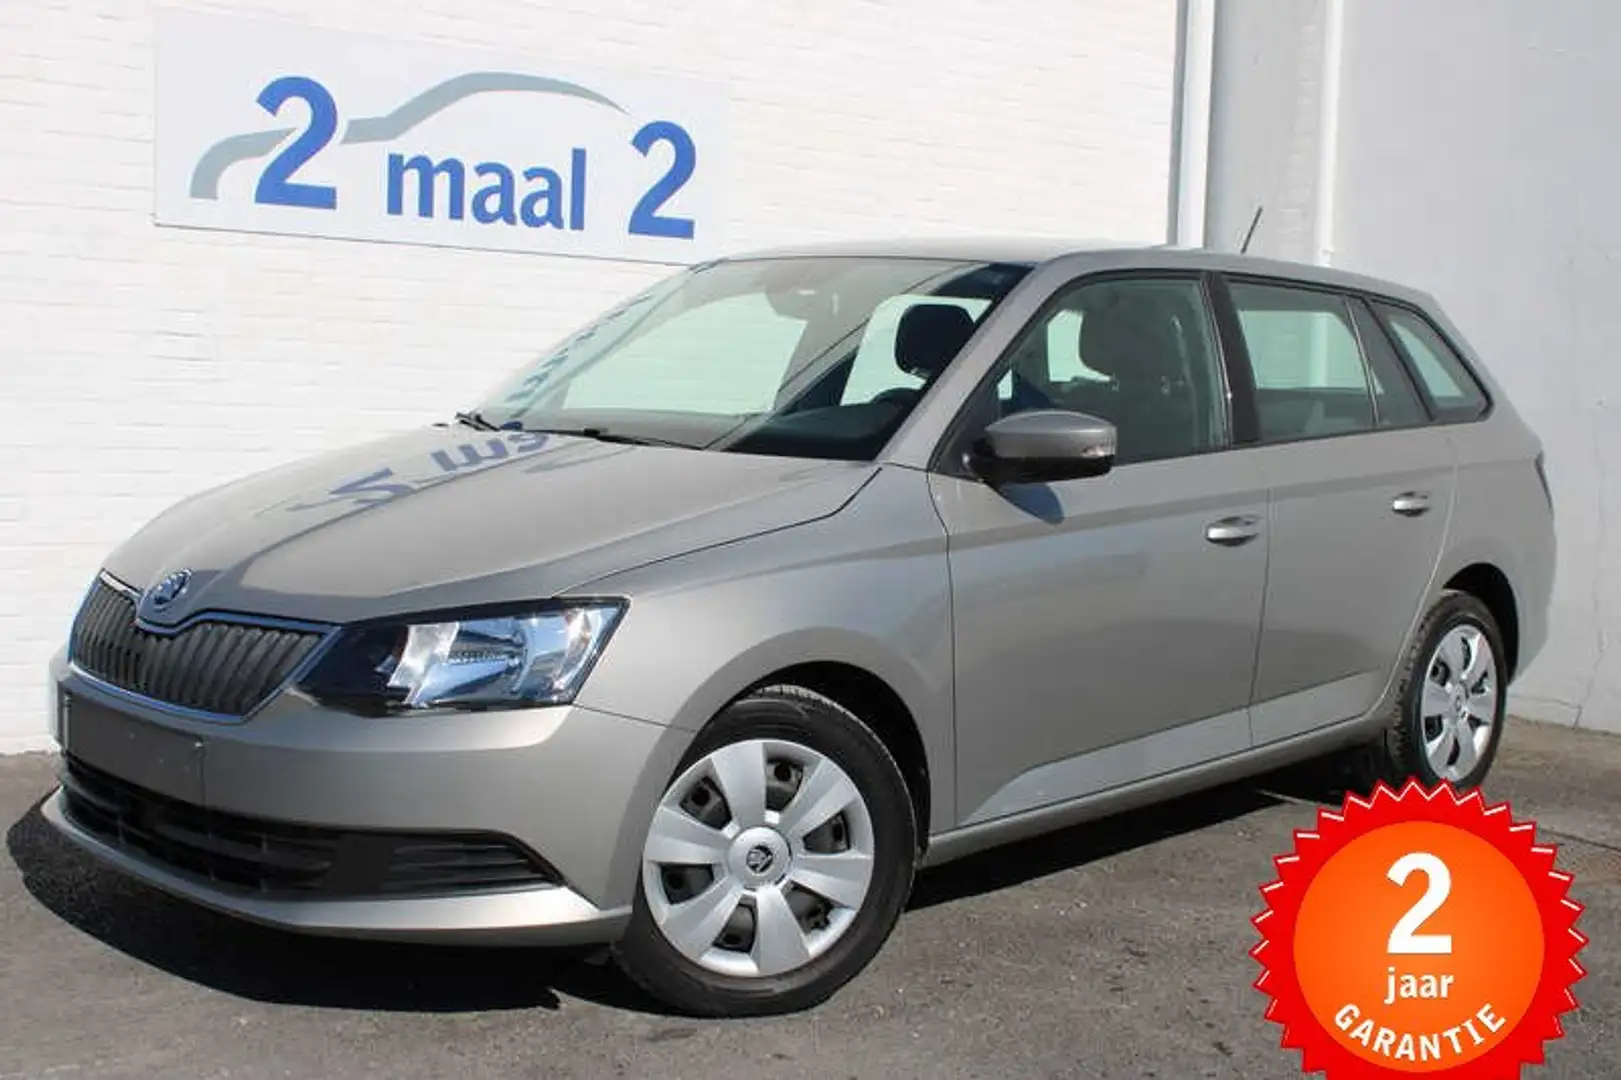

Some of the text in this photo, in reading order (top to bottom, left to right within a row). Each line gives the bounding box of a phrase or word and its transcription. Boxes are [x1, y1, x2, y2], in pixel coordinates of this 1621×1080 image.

[255, 76, 696, 240] 2 maal 2
